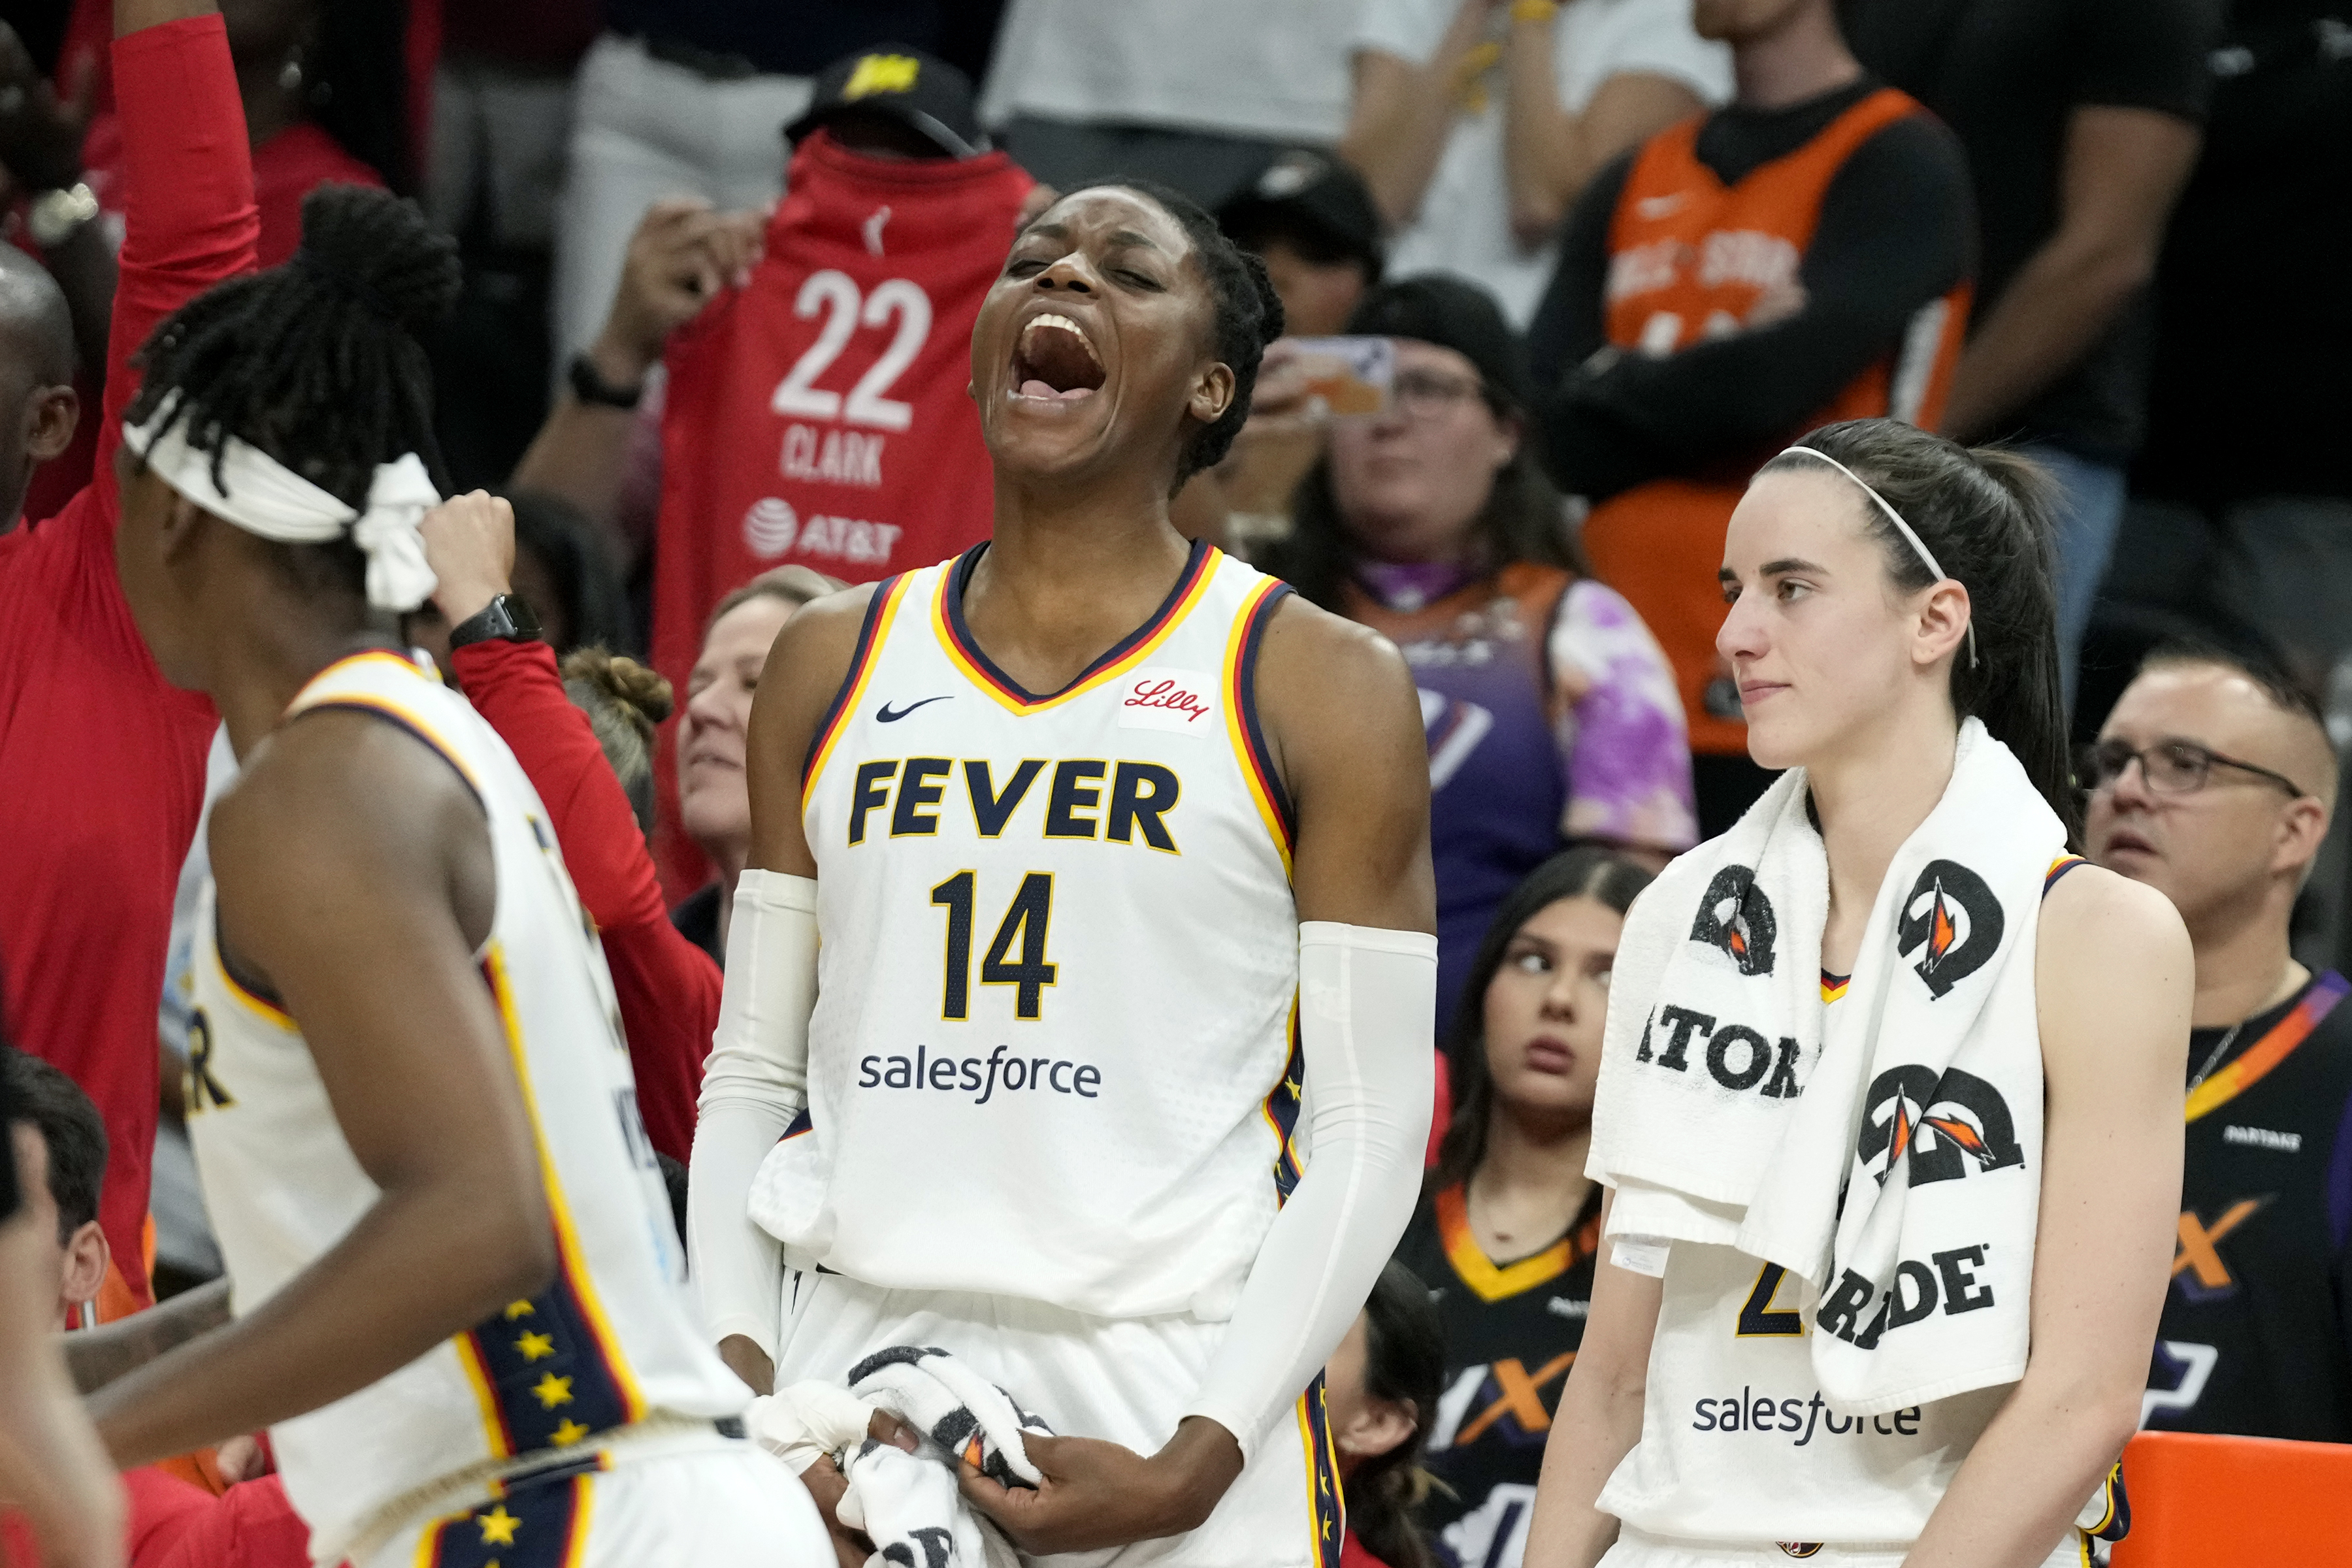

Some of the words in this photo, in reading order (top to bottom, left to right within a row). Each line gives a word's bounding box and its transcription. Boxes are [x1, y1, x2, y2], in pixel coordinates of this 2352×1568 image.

[772, 269, 931, 433] 22
[779, 425, 884, 491] CLARK
[799, 515, 902, 566] AT&T
[1124, 679, 1210, 722] Lilly
[848, 756, 1183, 856] FEVER
[930, 868, 1059, 1021] 14
[858, 1045, 1102, 1104] salesforce
